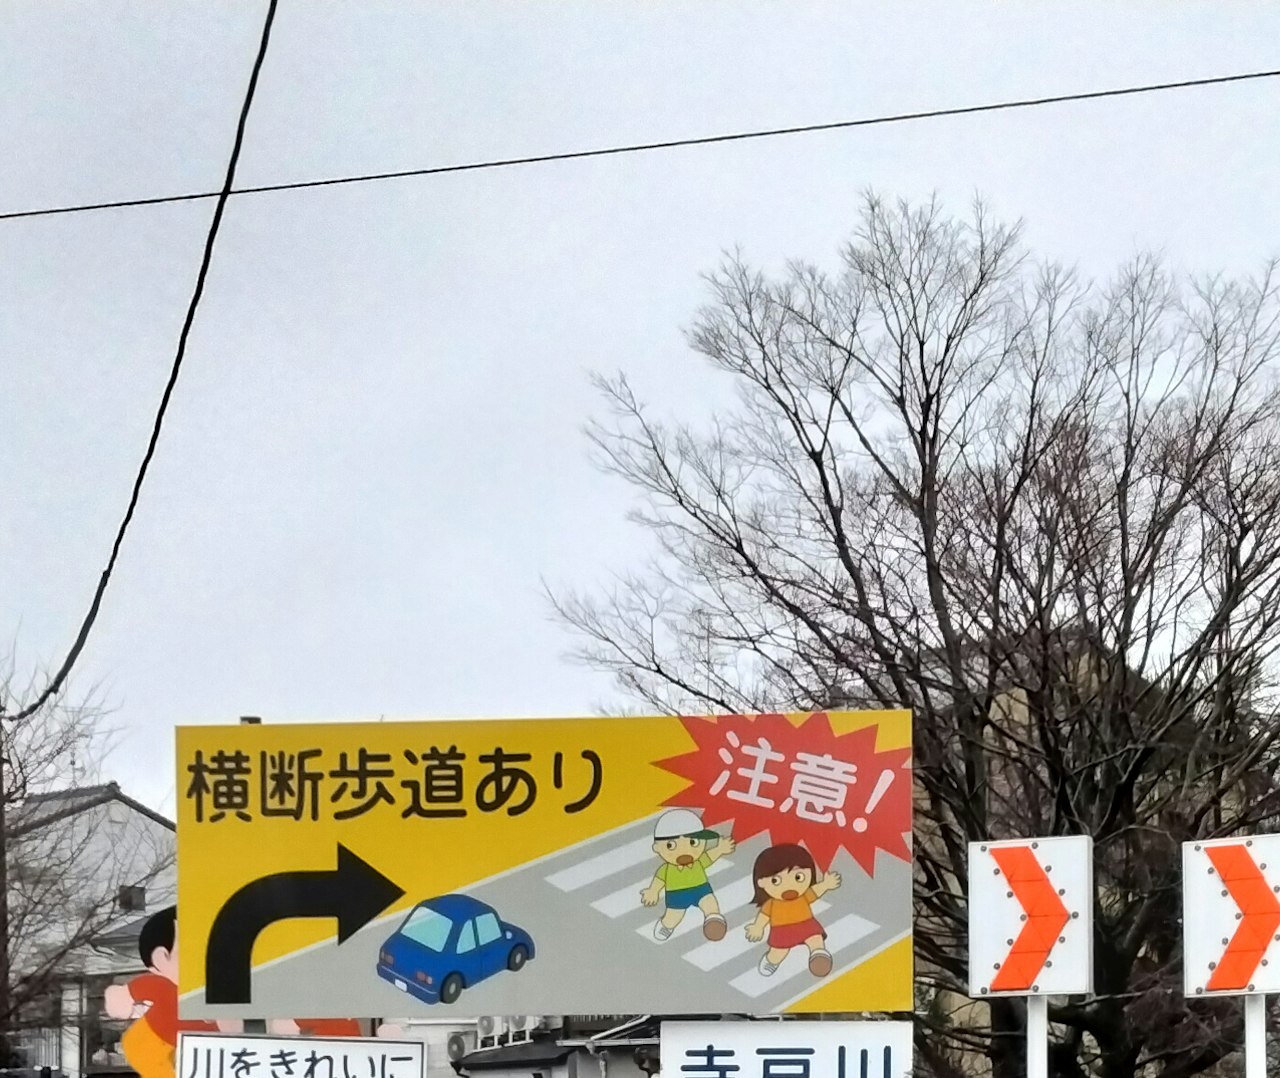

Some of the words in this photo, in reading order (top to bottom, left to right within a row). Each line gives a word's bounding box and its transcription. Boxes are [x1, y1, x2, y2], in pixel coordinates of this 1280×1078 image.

[186, 745, 603, 823] 横断歩道あり
